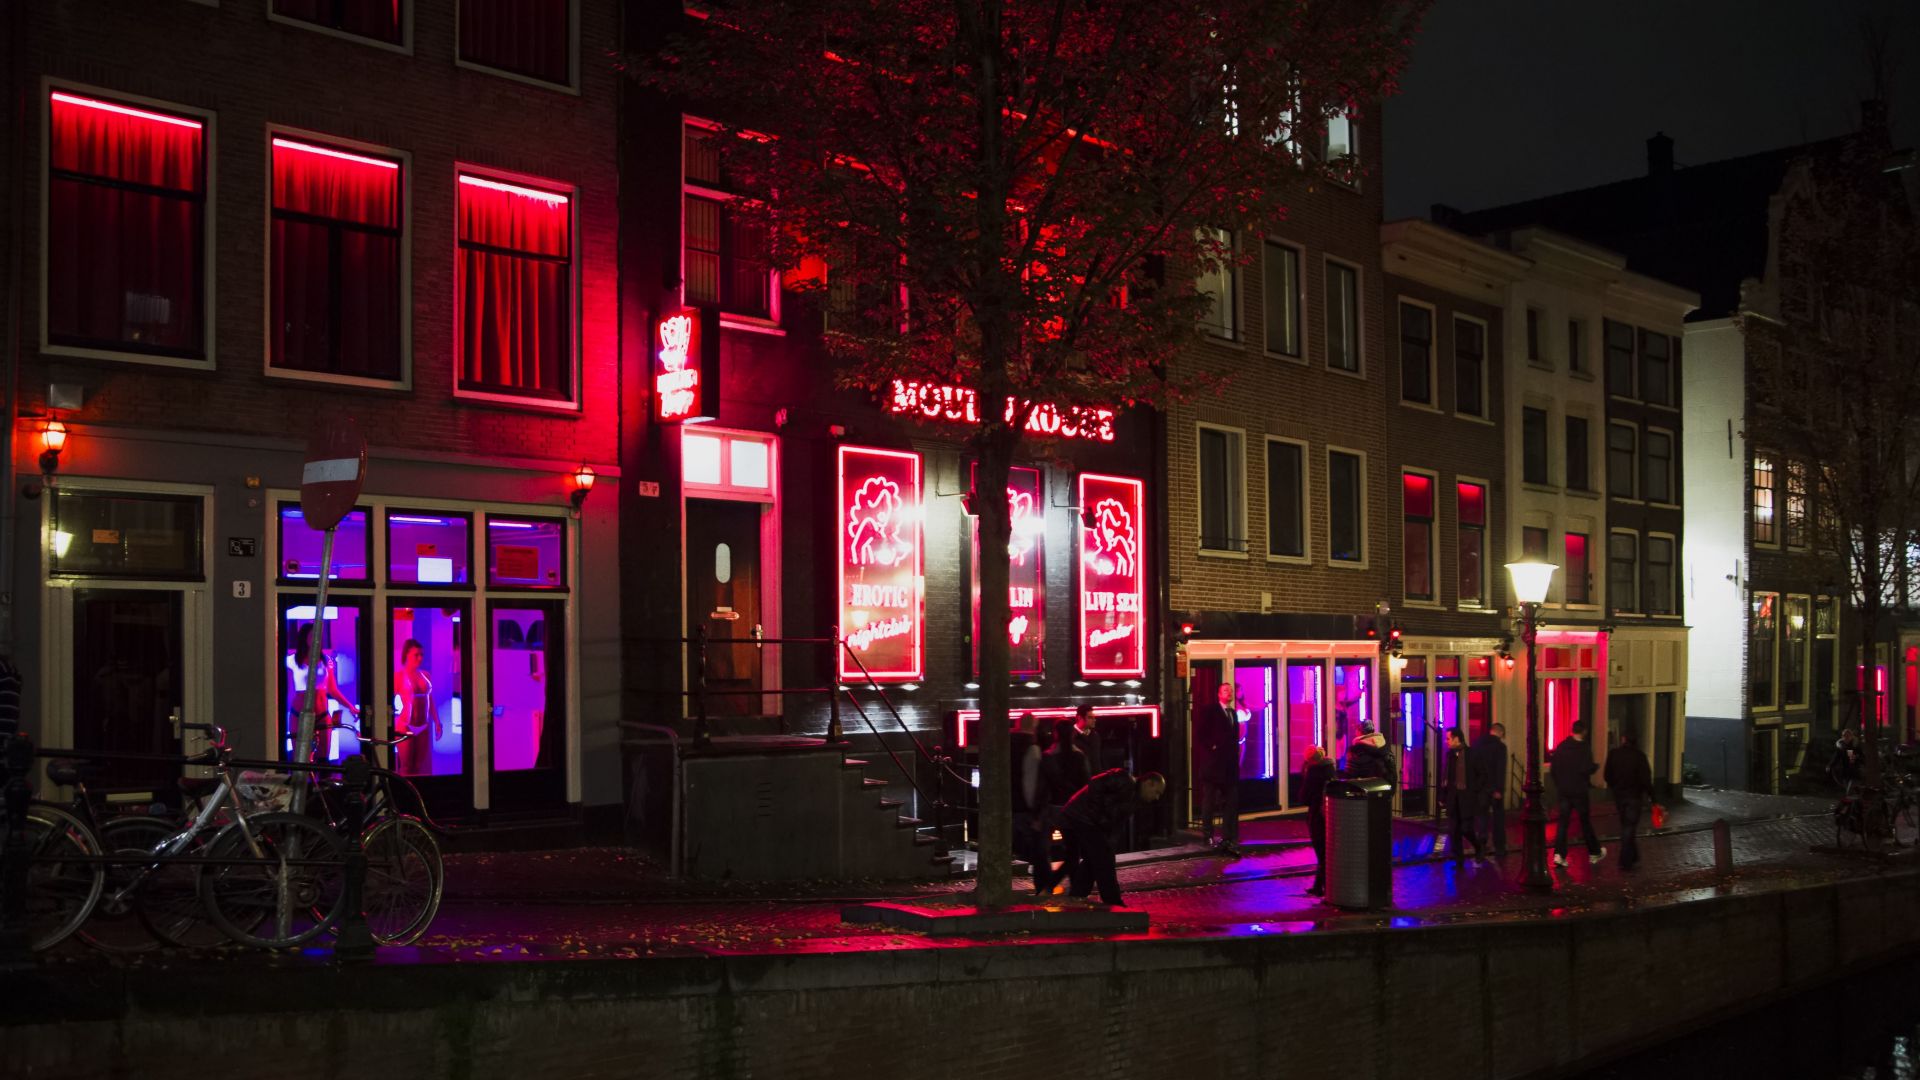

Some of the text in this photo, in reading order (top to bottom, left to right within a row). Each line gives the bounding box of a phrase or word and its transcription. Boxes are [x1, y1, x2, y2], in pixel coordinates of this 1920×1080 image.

[239, 582, 245, 597] 3
[851, 584, 908, 608] EROTIC
[1085, 592, 1138, 612] LIVE SEX
[848, 615, 913, 651] nightclub
